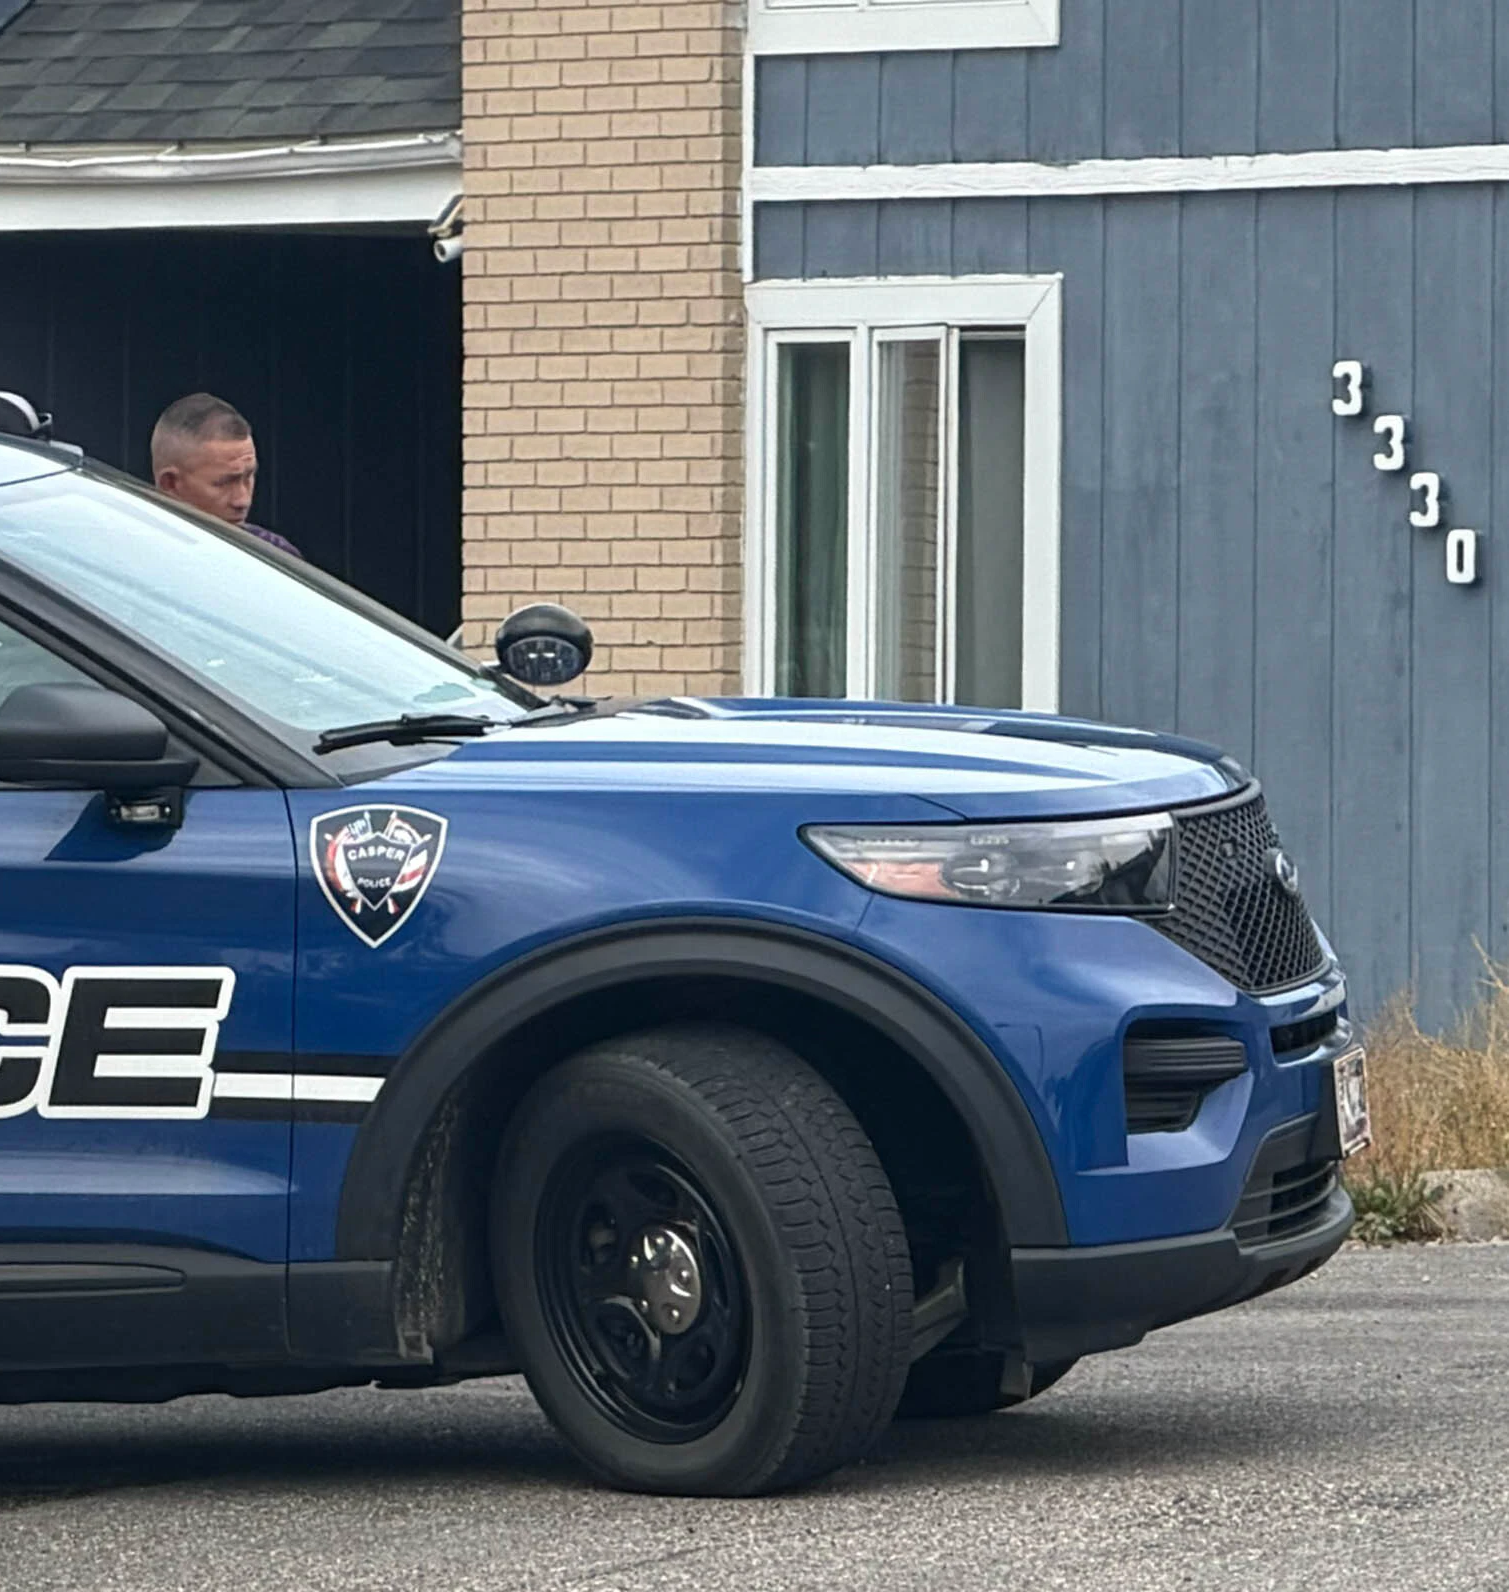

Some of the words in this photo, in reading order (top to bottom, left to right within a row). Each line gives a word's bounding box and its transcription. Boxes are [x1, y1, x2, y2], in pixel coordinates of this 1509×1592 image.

[1332, 360, 1476, 584] 3330
[348, 845, 406, 861] CASPER
[357, 877, 392, 888] POLICE
